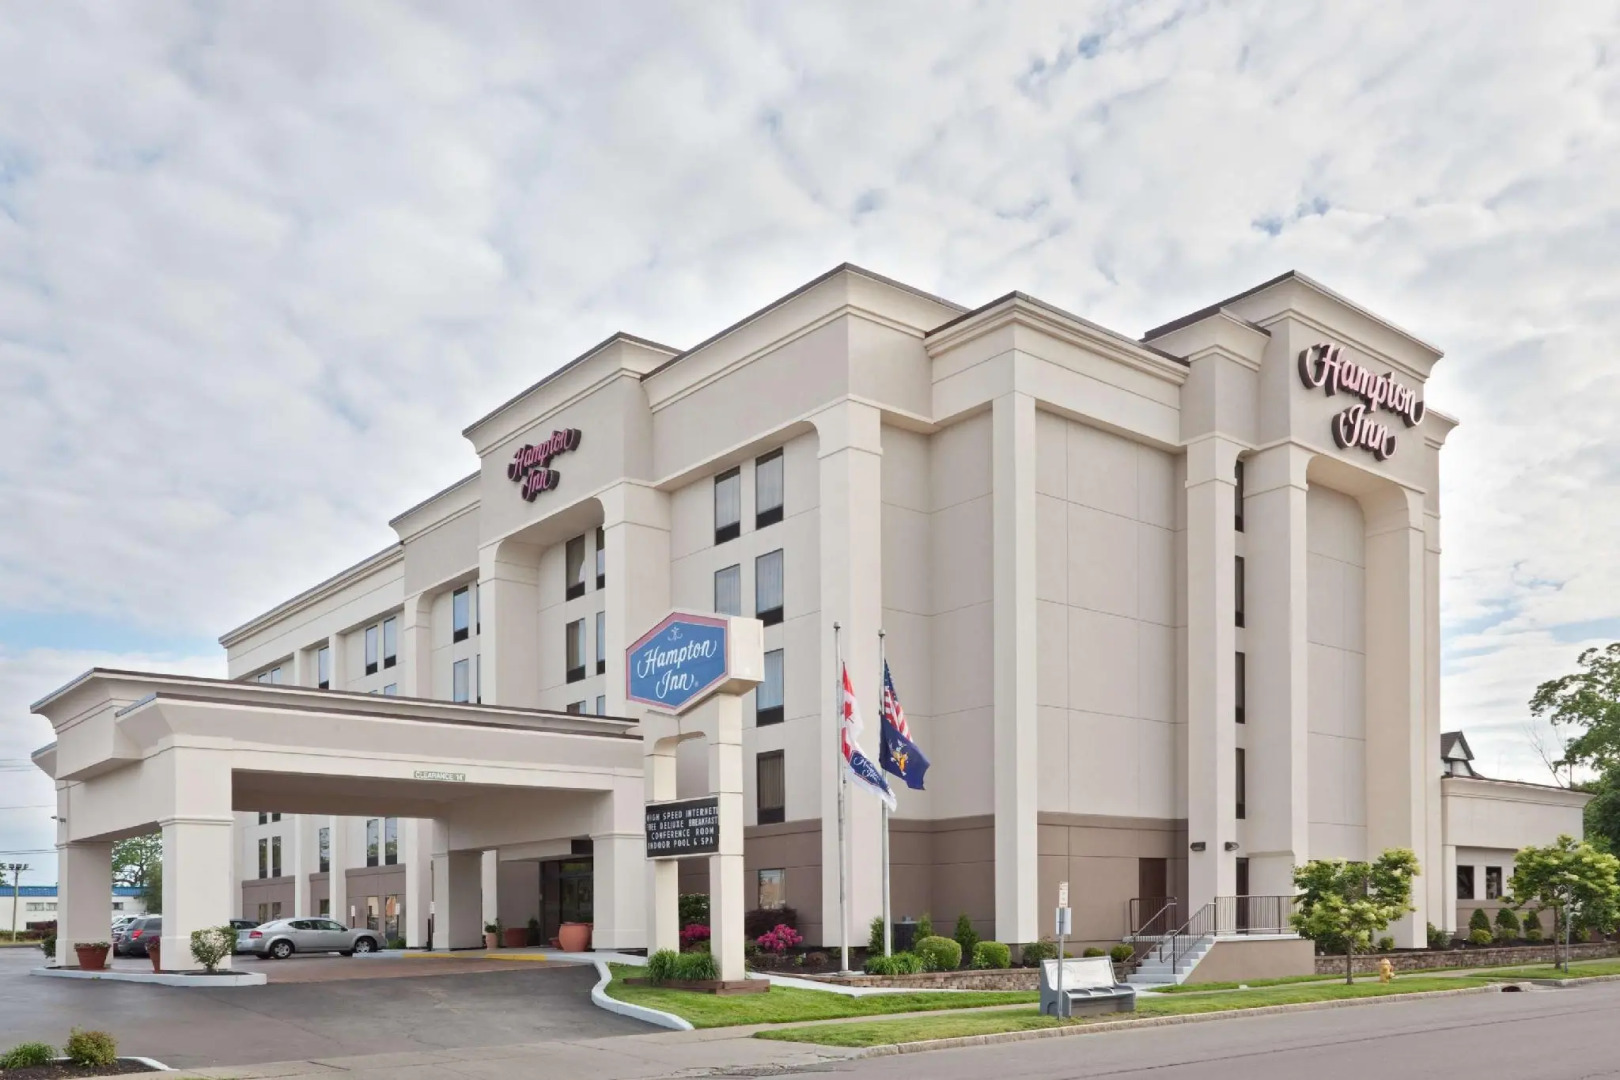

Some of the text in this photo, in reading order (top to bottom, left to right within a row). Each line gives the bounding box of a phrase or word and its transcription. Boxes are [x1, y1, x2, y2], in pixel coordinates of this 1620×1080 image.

[1298, 341, 1425, 428] Hampton
[1332, 403, 1397, 462] Inn
[507, 428, 582, 482] Hampton
[522, 468, 560, 502] Inn
[637, 639, 717, 679] Hampton
[656, 669, 694, 699] Inn
[415, 771, 454, 780] CLEARANCE
[663, 811, 683, 820] SPEED
[685, 807, 718, 817] INTERNET
[688, 817, 718, 826] BREAKFAST
[647, 841, 670, 850] INDOOR
[673, 839, 690, 848] POOL
[701, 837, 713, 845] SPA
[652, 827, 714, 839] CONFERENCE ROOM
